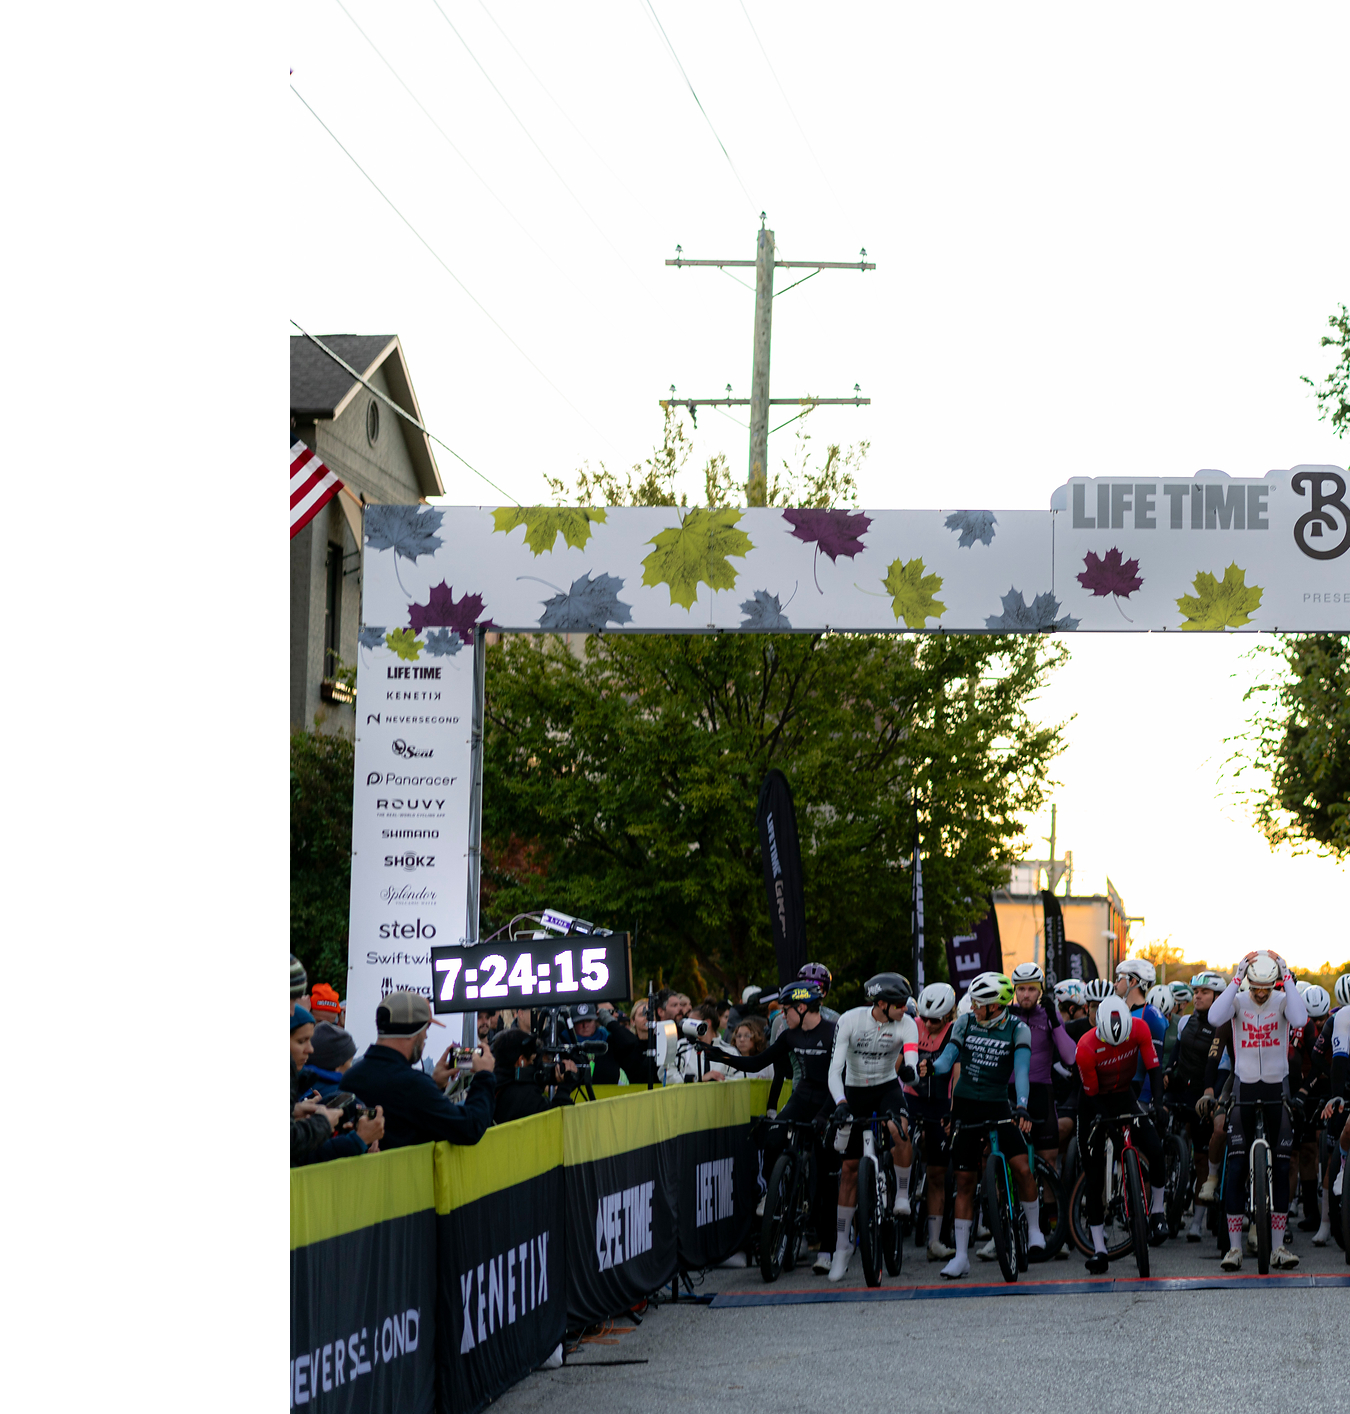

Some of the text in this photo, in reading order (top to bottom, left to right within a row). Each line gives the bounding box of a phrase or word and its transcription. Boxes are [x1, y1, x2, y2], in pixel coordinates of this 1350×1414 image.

[1073, 484, 1269, 530] LIFE TIME
[386, 691, 441, 700] KENETIK
[386, 716, 459, 724] NEVERSECOND
[386, 772, 457, 786] Panaracer
[377, 799, 446, 810] ROUVY
[382, 830, 440, 838] SHIMANO
[384, 855, 436, 867] SHOKZ
[380, 884, 437, 905] Splendor
[379, 918, 437, 939] stelo
[436, 947, 609, 1001] 7:24:15
[1242, 1021, 1278, 1032] LUNCH
[965, 1035, 1011, 1049] GIANT
[1249, 1032, 1271, 1040] BOX
[1241, 1039, 1280, 1048] RACING
[460, 1231, 549, 1355] KENETIK
